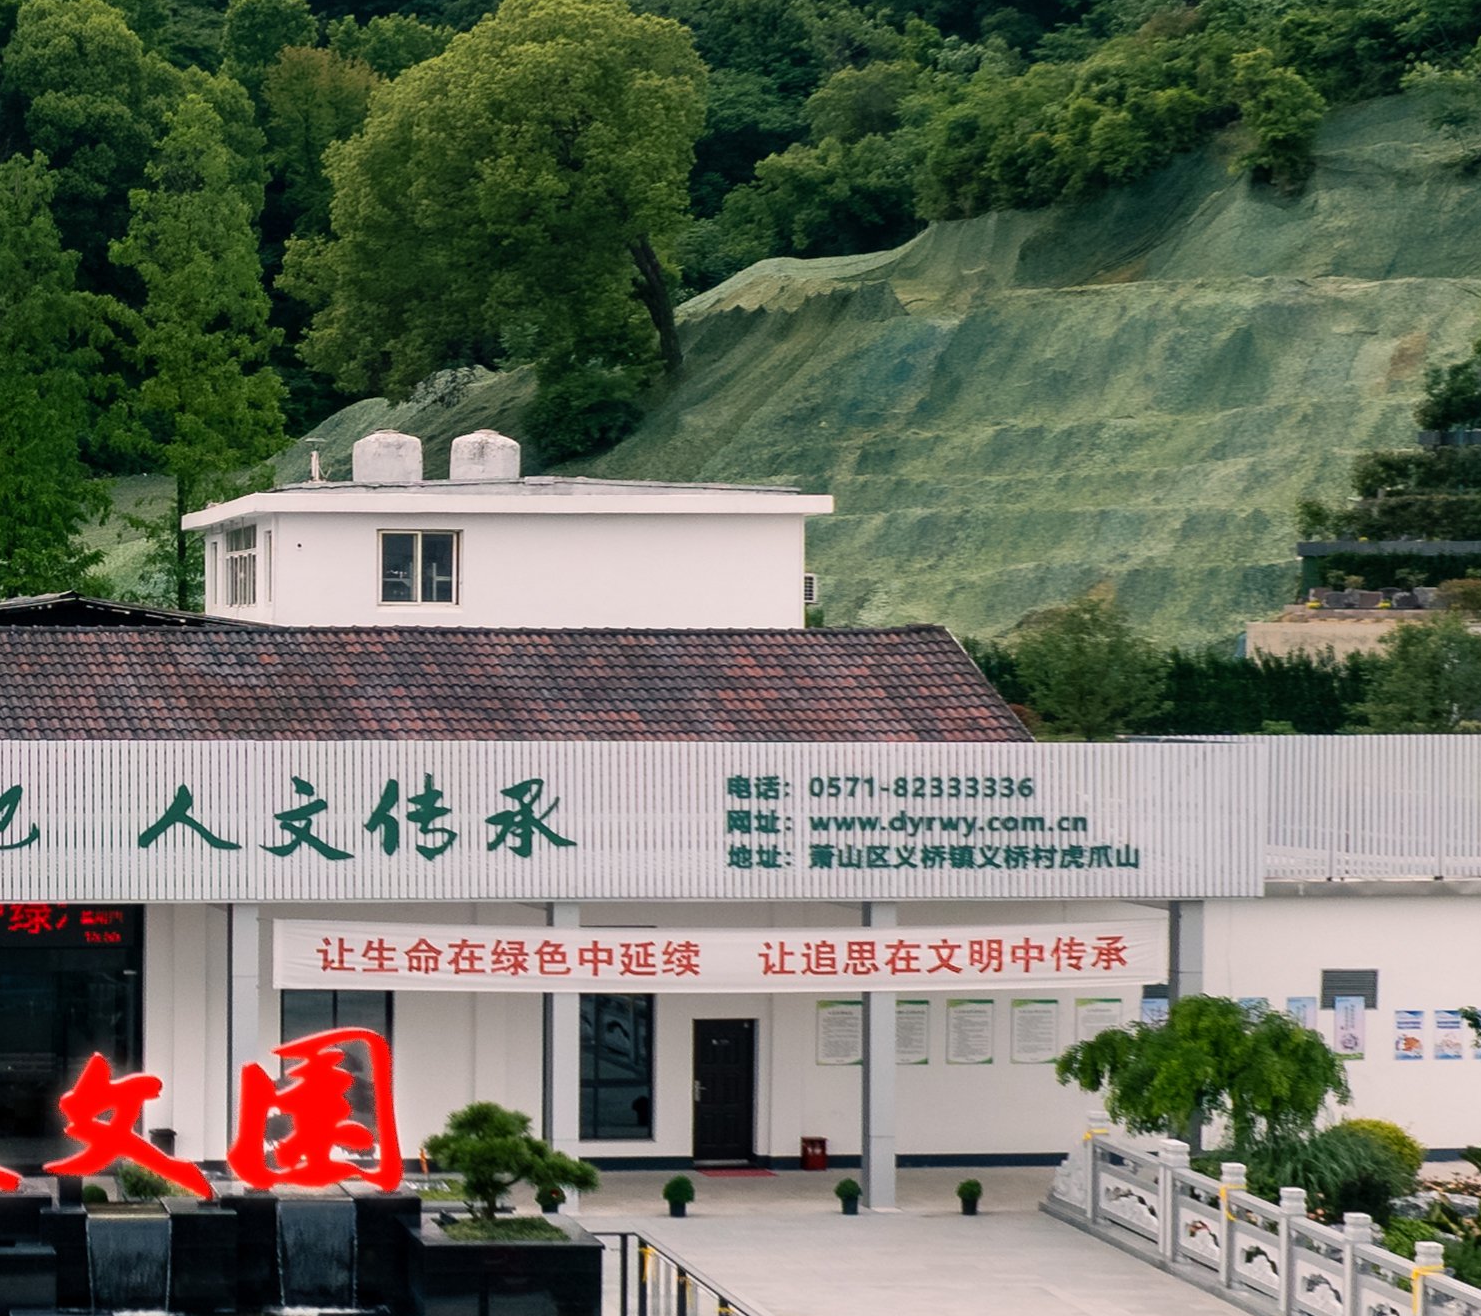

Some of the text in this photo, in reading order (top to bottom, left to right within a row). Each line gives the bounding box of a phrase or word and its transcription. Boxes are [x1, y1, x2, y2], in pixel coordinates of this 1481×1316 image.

[810, 777, 1034, 798] 0571-82333336
[137, 775, 576, 861] 人文传承
[810, 811, 1088, 836] www.dyrwy.com.cn
[809, 844, 1140, 870] 萧山区义桥镇义桥村虎爪山
[317, 935, 1128, 977] 让生命在绿色中延续 让追思在文明中传承
